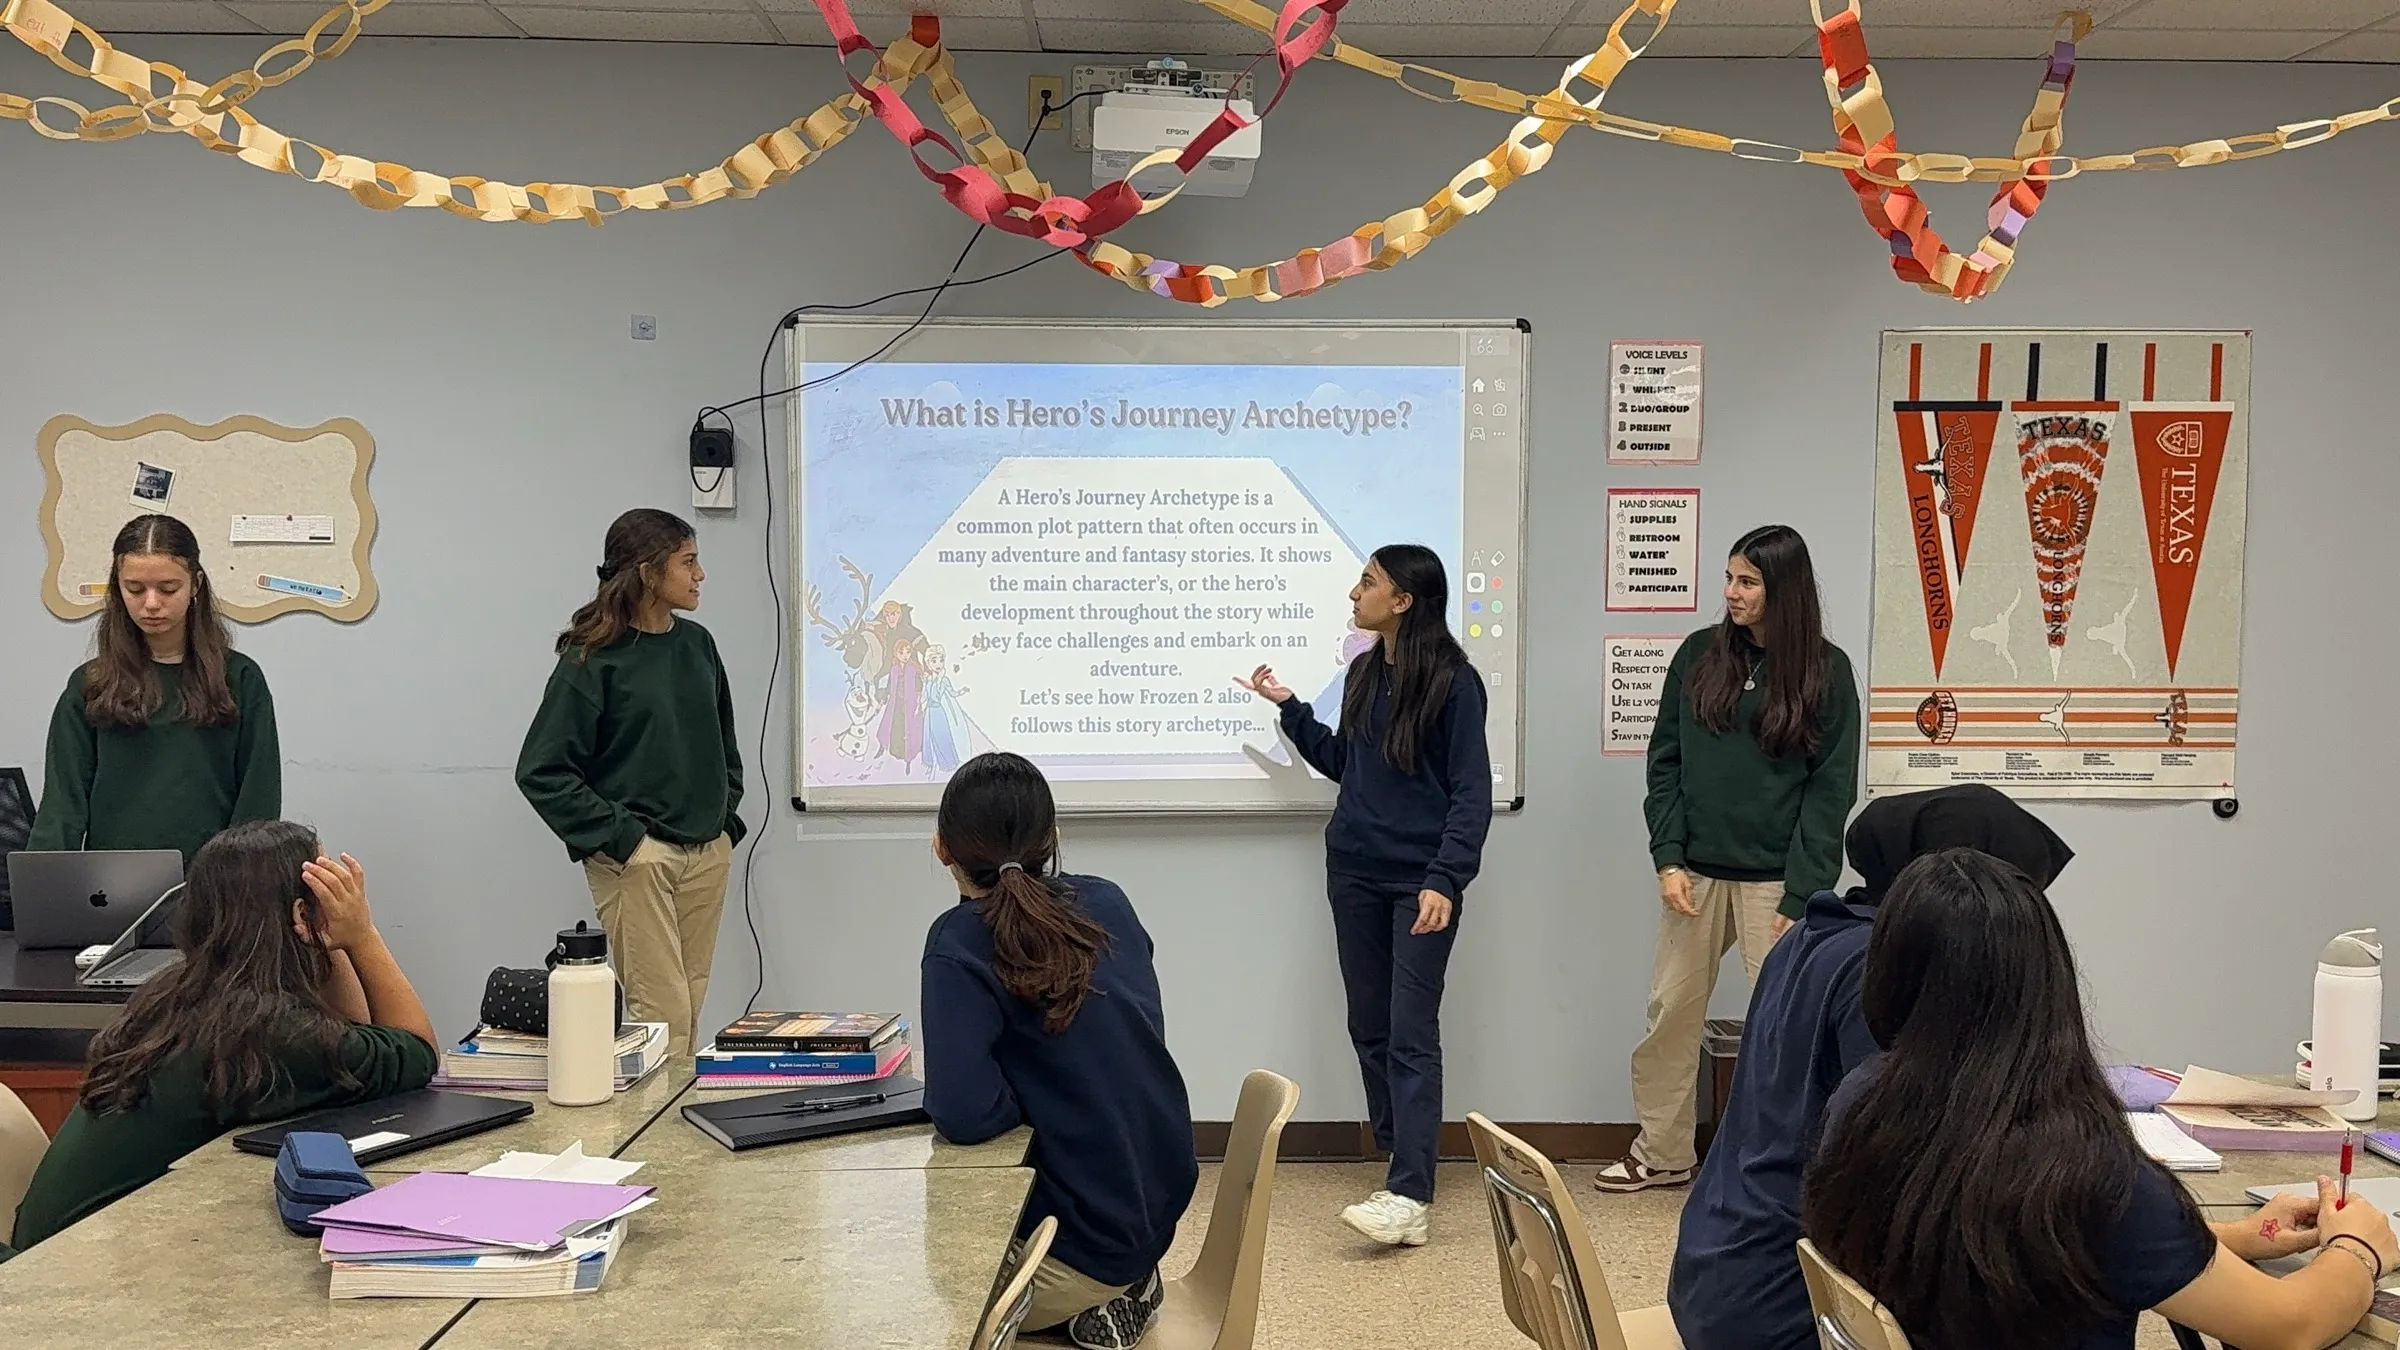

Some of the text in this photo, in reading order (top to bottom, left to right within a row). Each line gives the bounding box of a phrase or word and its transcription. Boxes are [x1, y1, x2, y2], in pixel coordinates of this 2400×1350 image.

[1166, 128, 1190, 136] EPSON
[1625, 351, 1688, 359] VOICE LEVELS
[1619, 383, 1626, 394] 1
[1619, 402, 1690, 413] 2 DUO/GROUP
[880, 399, 1413, 436] What is Hero’s Journey Archetype?
[1618, 421, 1671, 432] 3 PRESENT
[2022, 416, 2107, 441] TEXAS
[1617, 440, 1670, 451] 4 OUTSIDE
[1939, 416, 1975, 519] TEXAS
[998, 488, 1274, 510] A Hero’s Journey Archetype is a
[1620, 500, 1687, 508] HAND SIGNALS
[1630, 515, 1677, 524] SUPPLIES
[2168, 463, 2196, 564] TEXAS
[957, 517, 1319, 539] common plot pattern that often occurs in
[1629, 534, 1681, 542] RESTROOM
[938, 546, 1332, 568] many adventure and fantasy stories. It shows
[1914, 494, 1948, 630] LONGHORNS
[989, 574, 1287, 595] the main character’s, or the hero’s
[2050, 552, 2064, 643] LONGHORNS
[961, 603, 1314, 625] development throughout the story while
[972, 631, 1308, 654] they face challenges and embark on an
[1612, 645, 1632, 657] GET
[1090, 660, 1182, 677] adventure.
[1612, 662, 1650, 673] RESPECT
[1612, 678, 1629, 690] ON
[1020, 687, 1252, 705] Let’s see how Frozen 2 also
[1612, 695, 1632, 706] USE
[1612, 711, 1658, 723] PARTICIPA
[2168, 689, 2188, 747] TEXAS
[1011, 717, 1072, 733] follows
[1078, 717, 1111, 733] this
[1116, 719, 1162, 737] story
[1612, 729, 1632, 740] STAY
